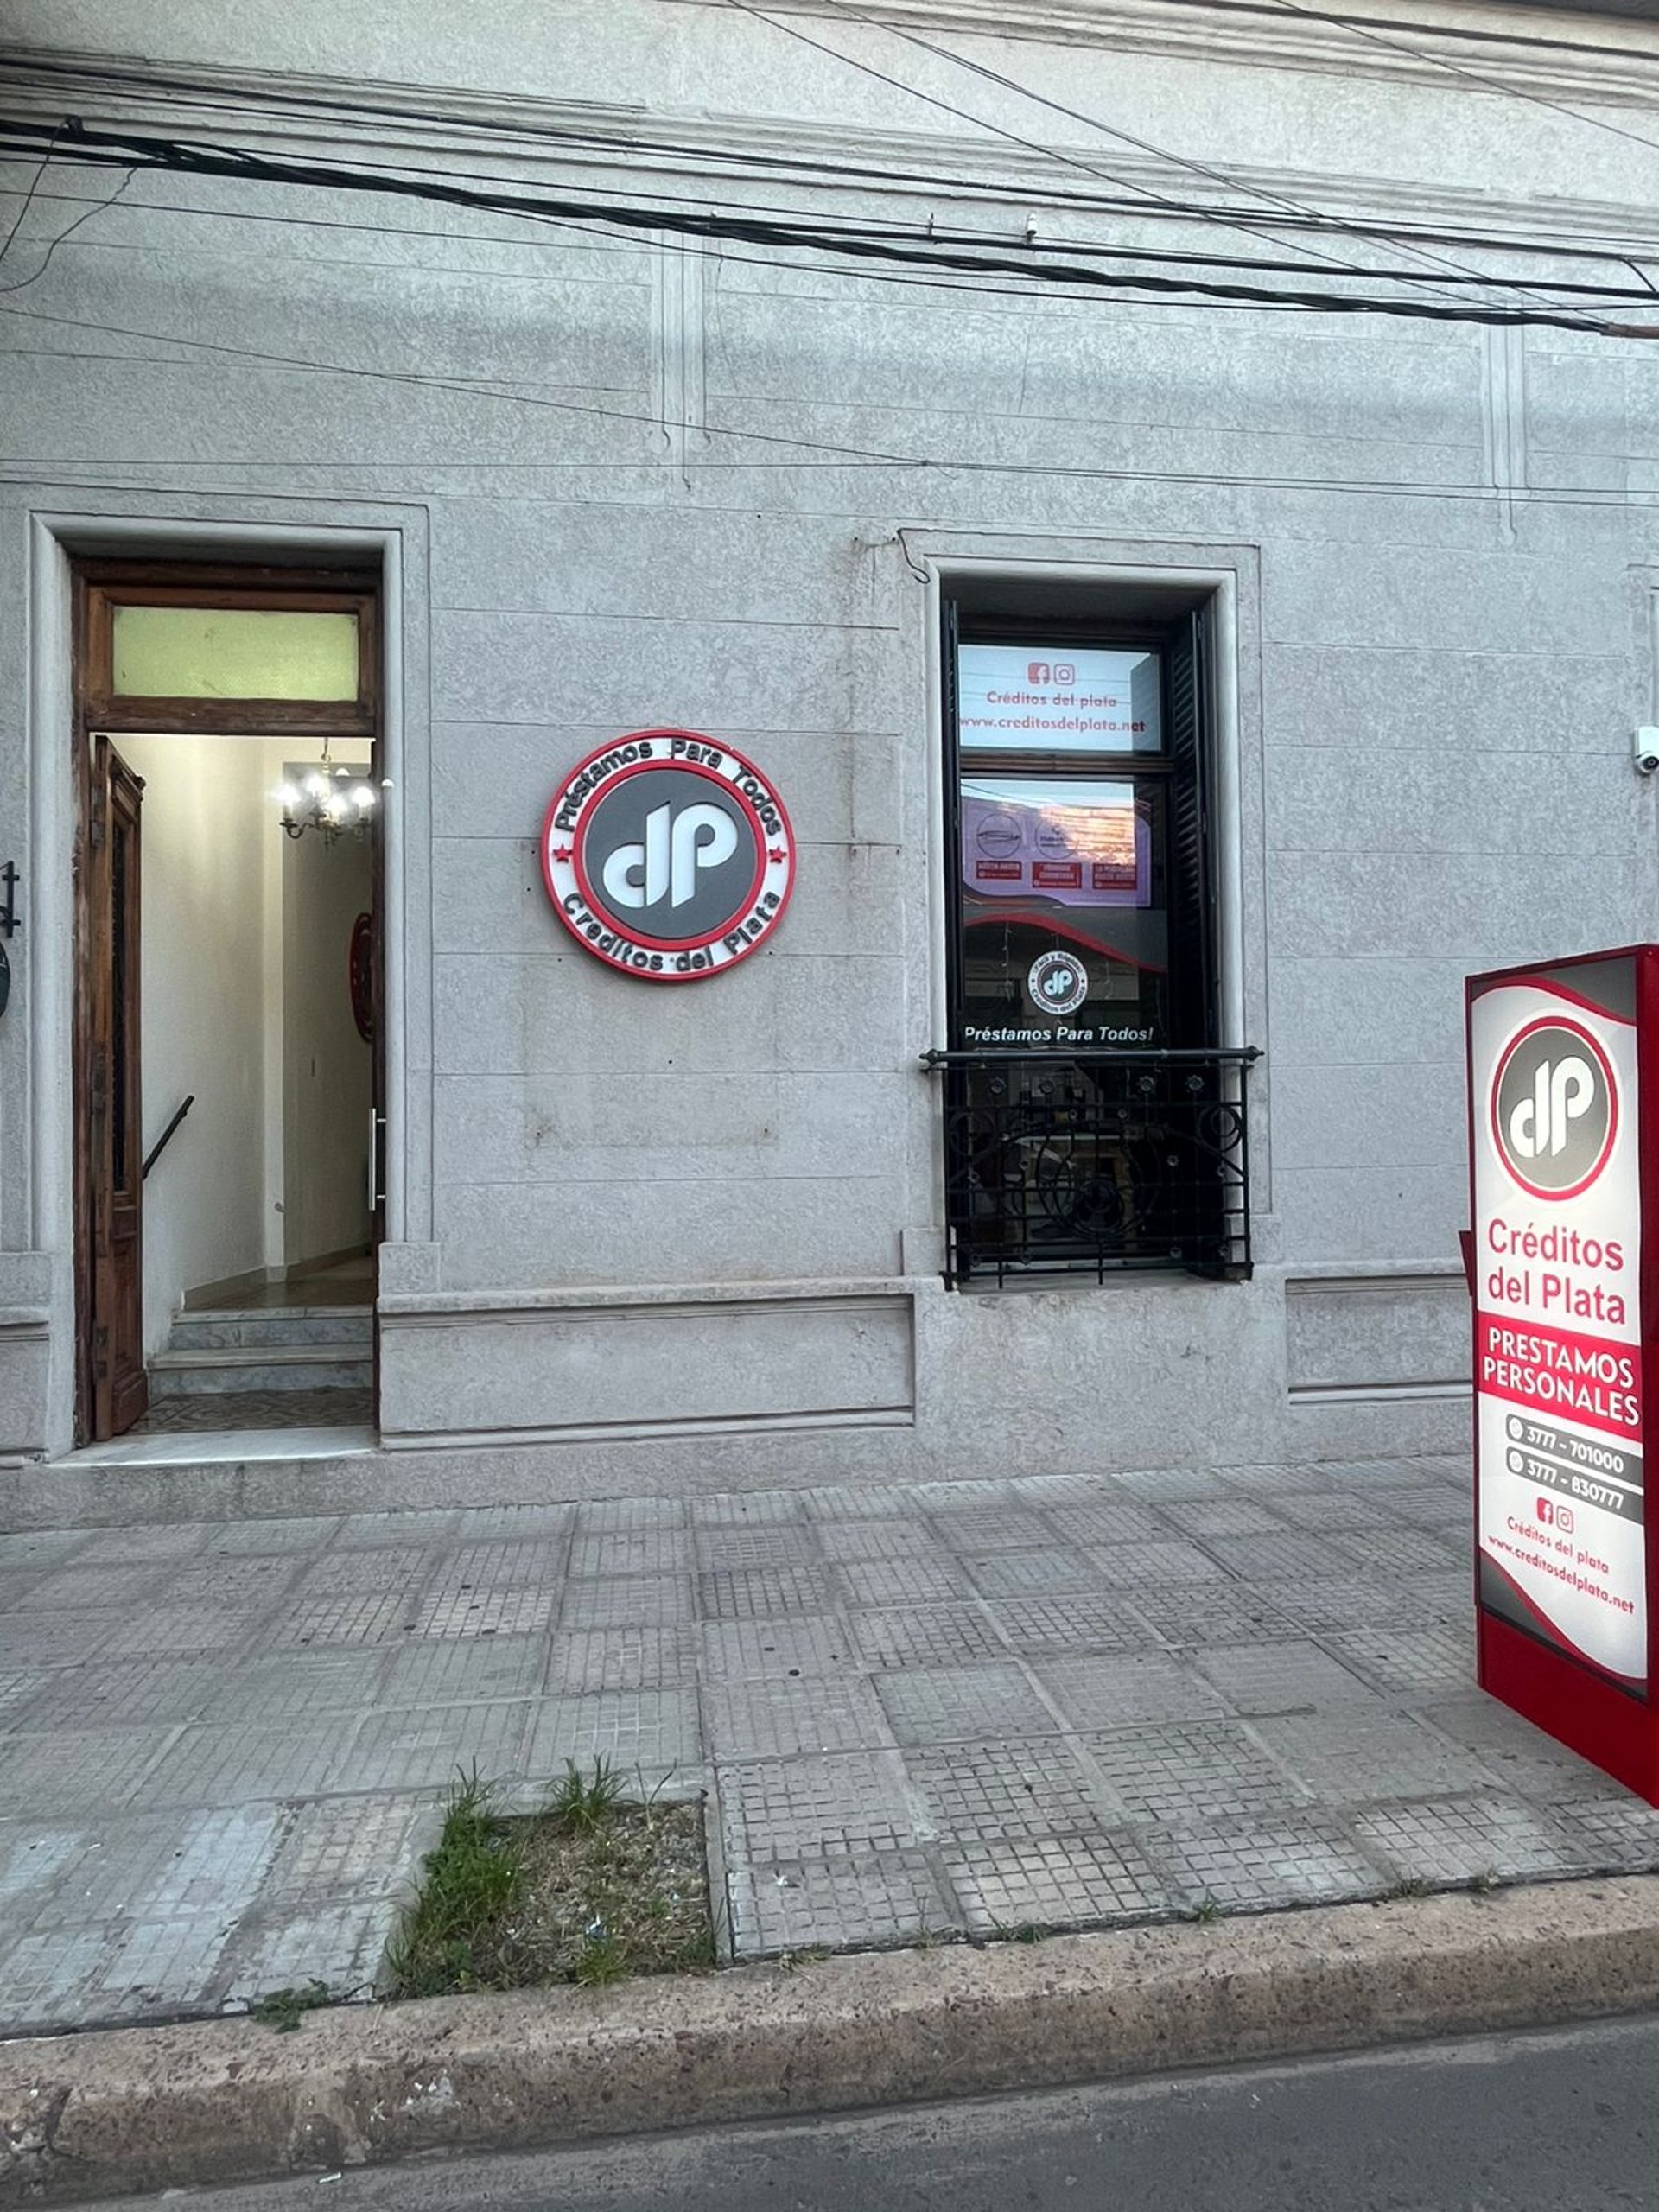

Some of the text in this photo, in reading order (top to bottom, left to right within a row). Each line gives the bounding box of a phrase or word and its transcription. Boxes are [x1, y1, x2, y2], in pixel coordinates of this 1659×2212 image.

[987, 690, 1116, 709] Créditos del plata
[555, 738, 782, 836] Préstamos Para Todos
[675, 946, 714, 972] del
[724, 891, 780, 955] Plata
[965, 1022, 1154, 1041] Préstamos Para Todos!
[1488, 1218, 1624, 1271] Créditos
[1488, 1266, 1625, 1325] del Plata
[1489, 1326, 1634, 1389] PRESTAMOS
[1484, 1357, 1640, 1426] PERSONALES
[1569, 1440, 1624, 1473] 701000
[1571, 1476, 1624, 1510] 830777
[1507, 1516, 1609, 1574] Créditos del plata
[1488, 1535, 1634, 1614] www.creditosdelplata.net
